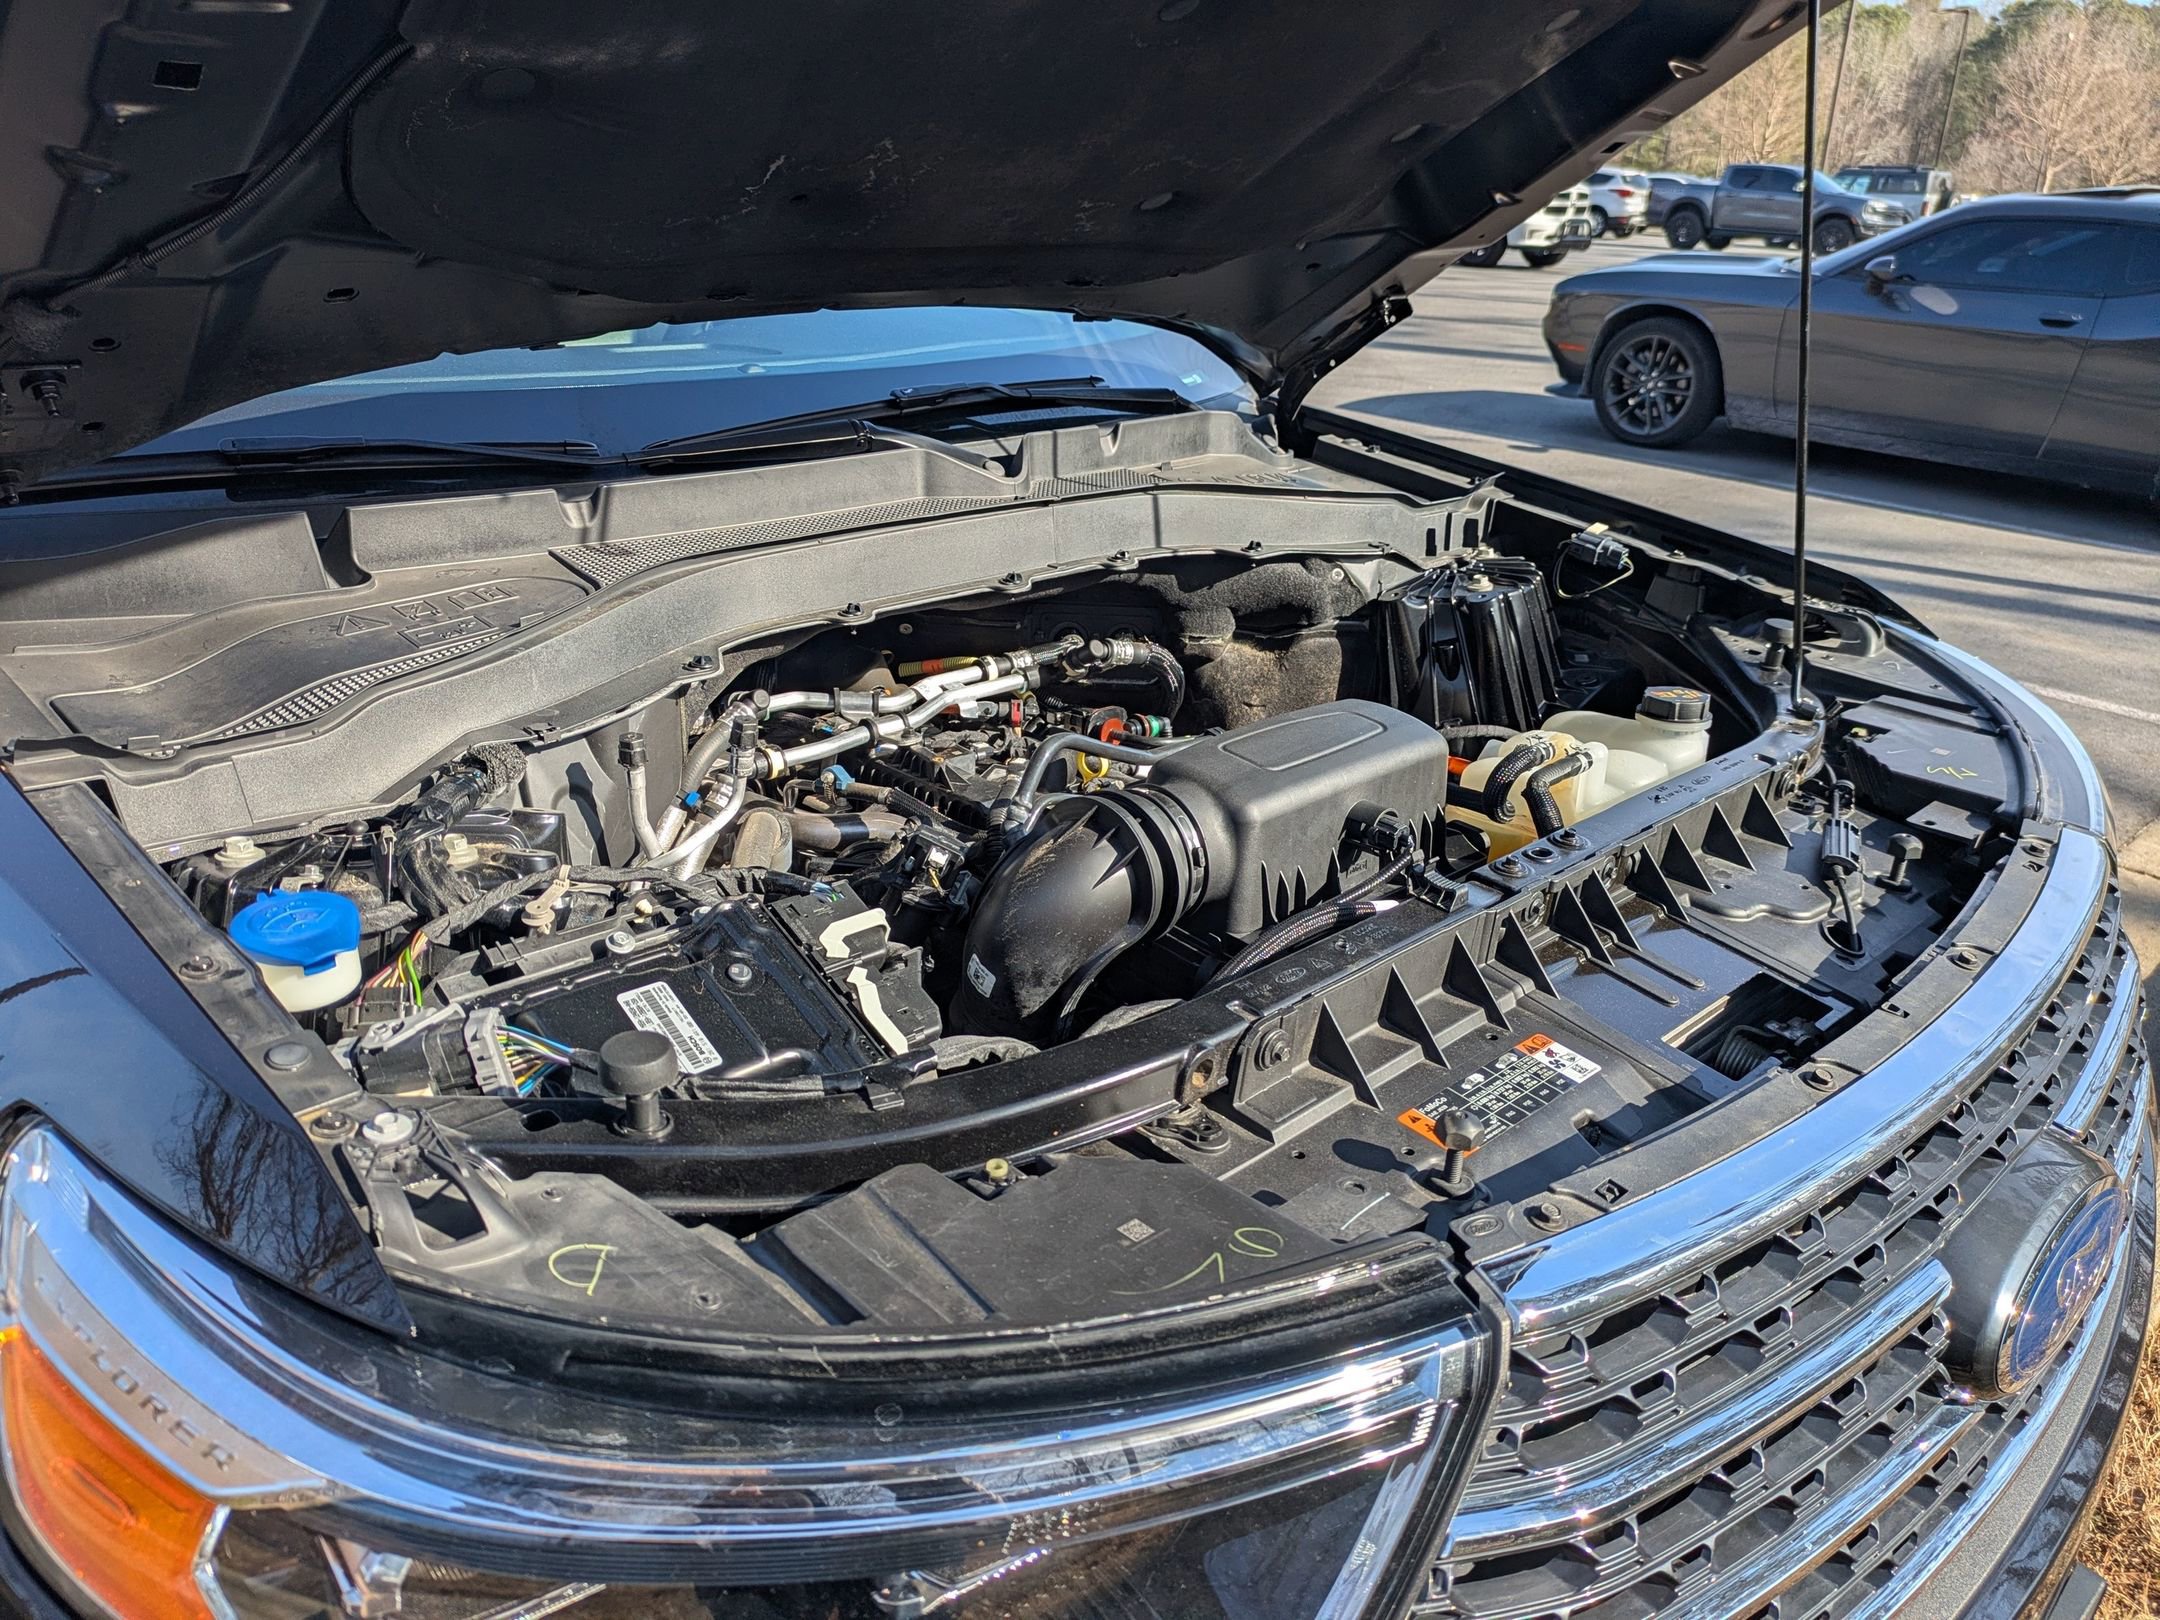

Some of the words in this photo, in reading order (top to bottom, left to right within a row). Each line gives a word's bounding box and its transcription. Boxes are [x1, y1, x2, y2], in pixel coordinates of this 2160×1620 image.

[688, 1035, 705, 1055] BOSCH
[1418, 1096, 1448, 1114] FoMoCo
[34, 1275, 237, 1473] PLORER
